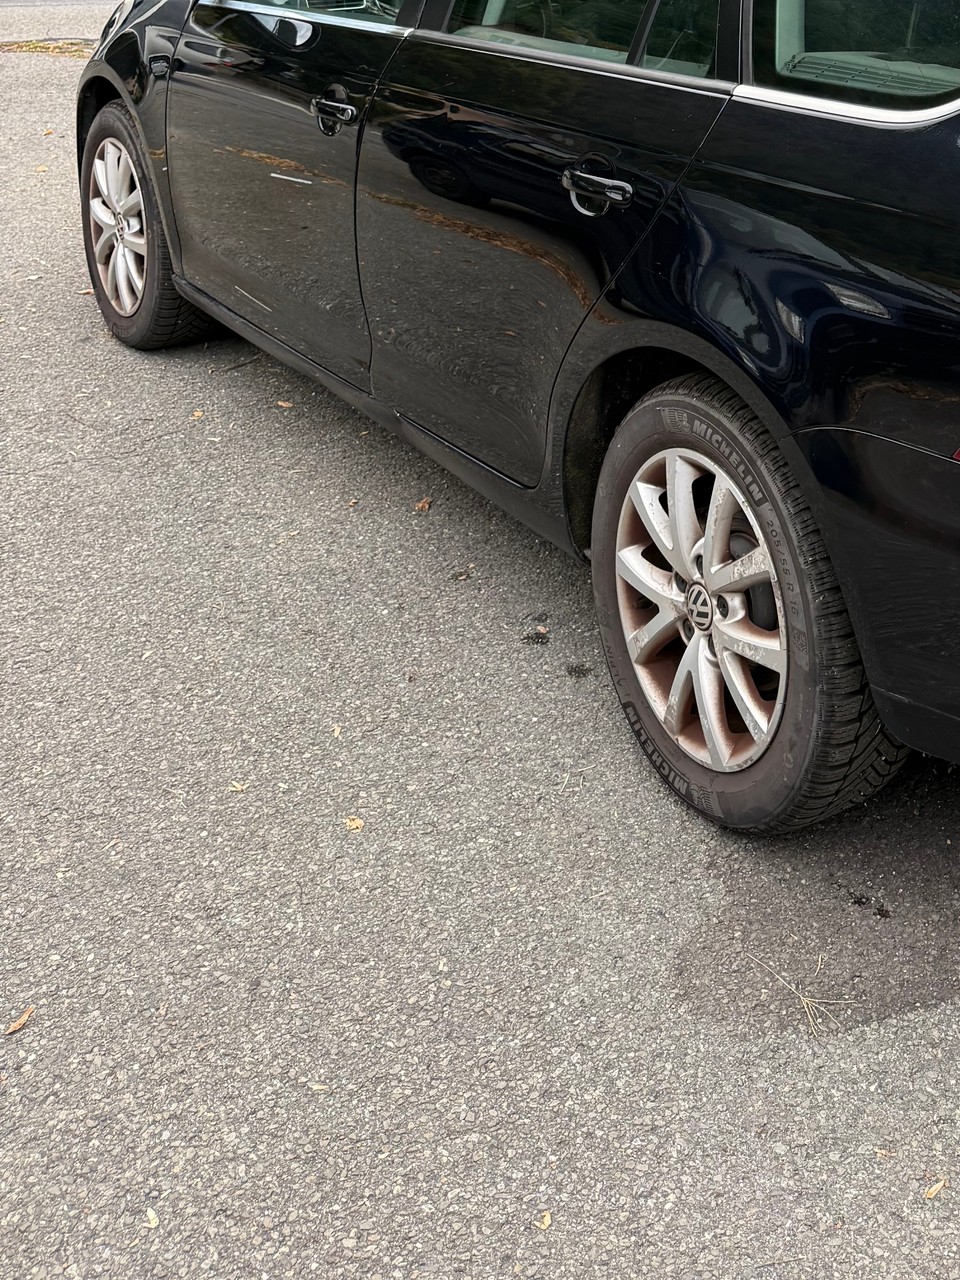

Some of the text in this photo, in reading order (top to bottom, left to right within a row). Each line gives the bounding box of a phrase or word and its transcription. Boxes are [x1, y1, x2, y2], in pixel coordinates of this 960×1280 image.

[692, 419, 764, 502] MICHELIN
[766, 519, 793, 577] 205/55
[786, 581, 795, 593] R
[625, 706, 688, 795] MICHELIN
